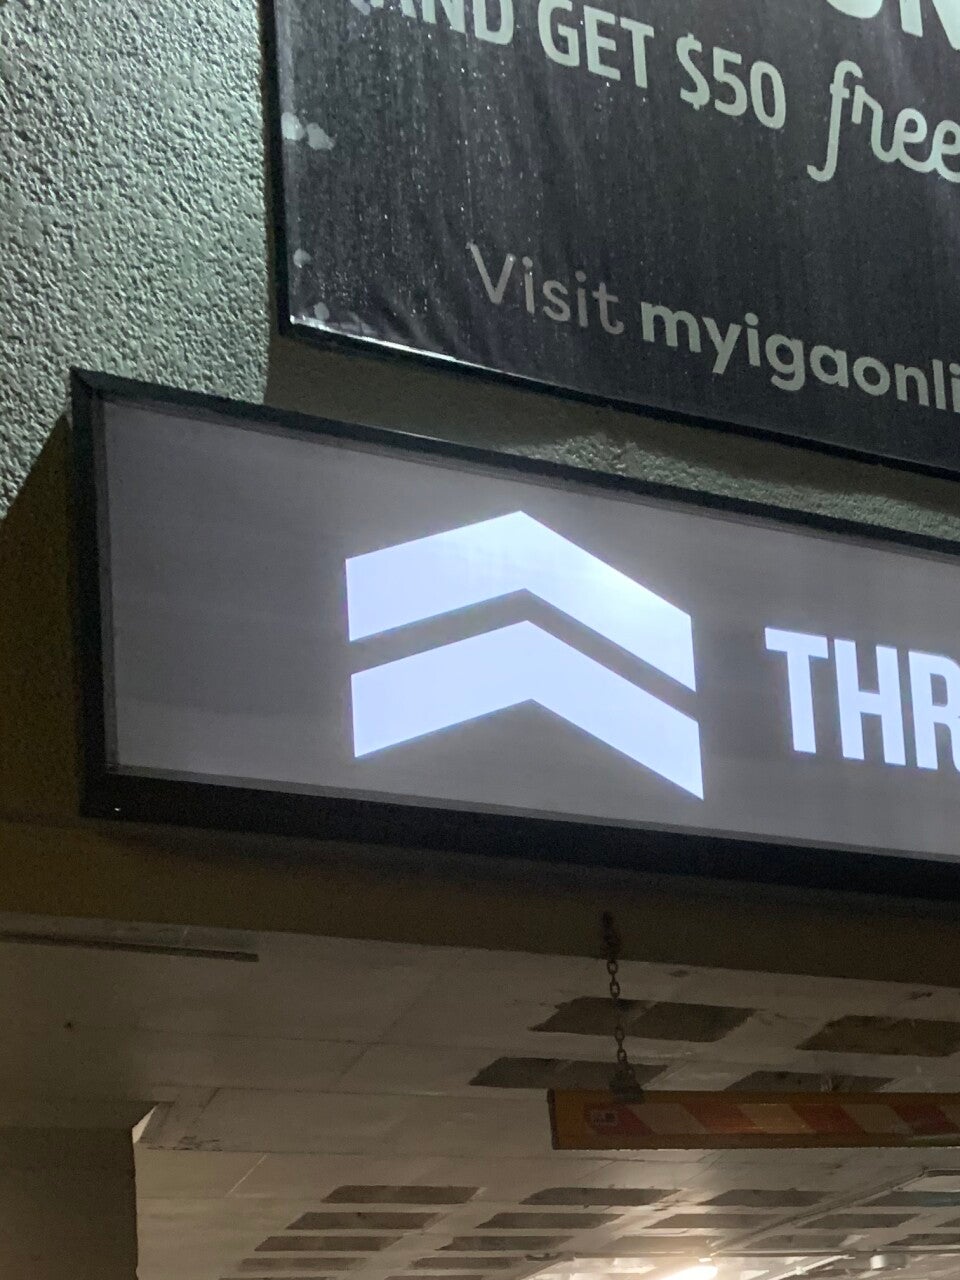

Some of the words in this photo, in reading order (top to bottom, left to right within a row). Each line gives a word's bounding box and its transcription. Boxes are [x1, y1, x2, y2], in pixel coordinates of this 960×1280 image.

[537, 0, 654, 89] GET
[676, 33, 786, 130] $50
[466, 240, 624, 334] Visit
